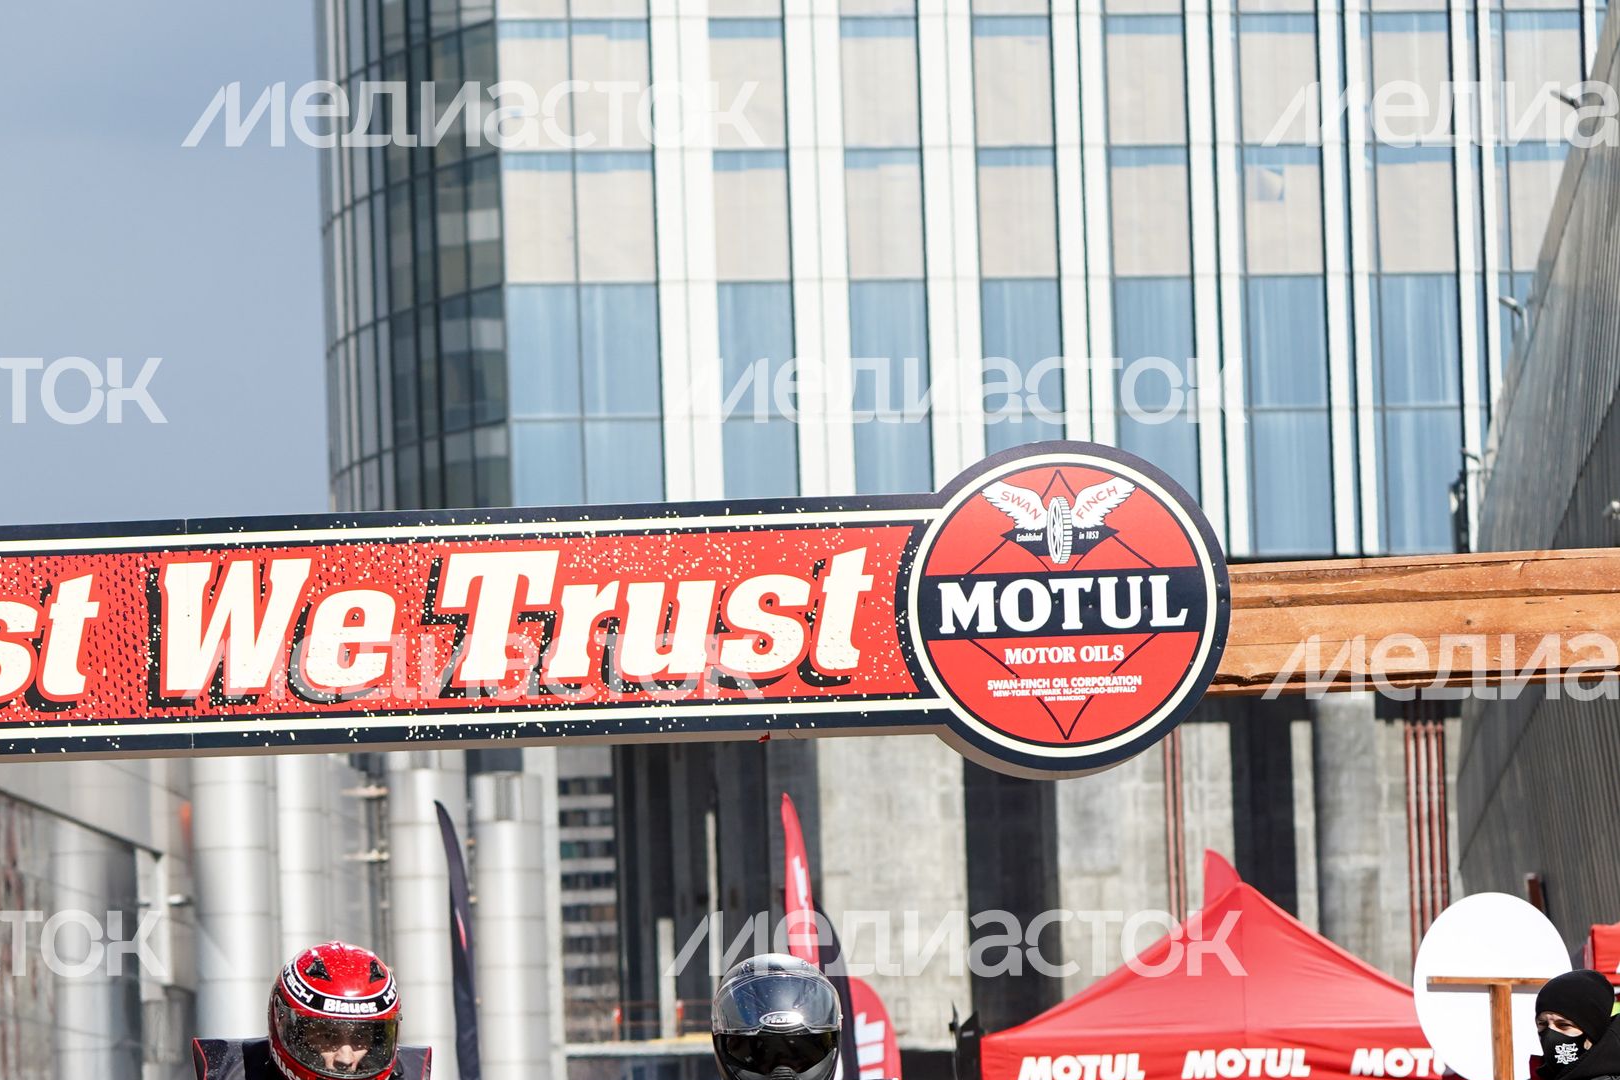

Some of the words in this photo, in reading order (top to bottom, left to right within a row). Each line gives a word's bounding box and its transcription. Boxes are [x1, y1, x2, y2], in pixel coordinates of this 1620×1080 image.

[1000, 490, 1041, 520] SWAN
[1076, 485, 1118, 520] FINCH
[162, 557, 396, 692] We
[440, 546, 875, 690] Trust
[937, 575, 1188, 634] MOTUL
[1004, 647, 1077, 665] MOTOR
[1080, 645, 1125, 662] OILS
[987, 678, 1050, 691] SWAN-FINCH
[1052, 677, 1069, 688] OIL
[1070, 675, 1142, 688] CORPORATION
[1181, 1048, 1311, 1080] MOTUL
[1350, 1048, 1457, 1078] MOT
